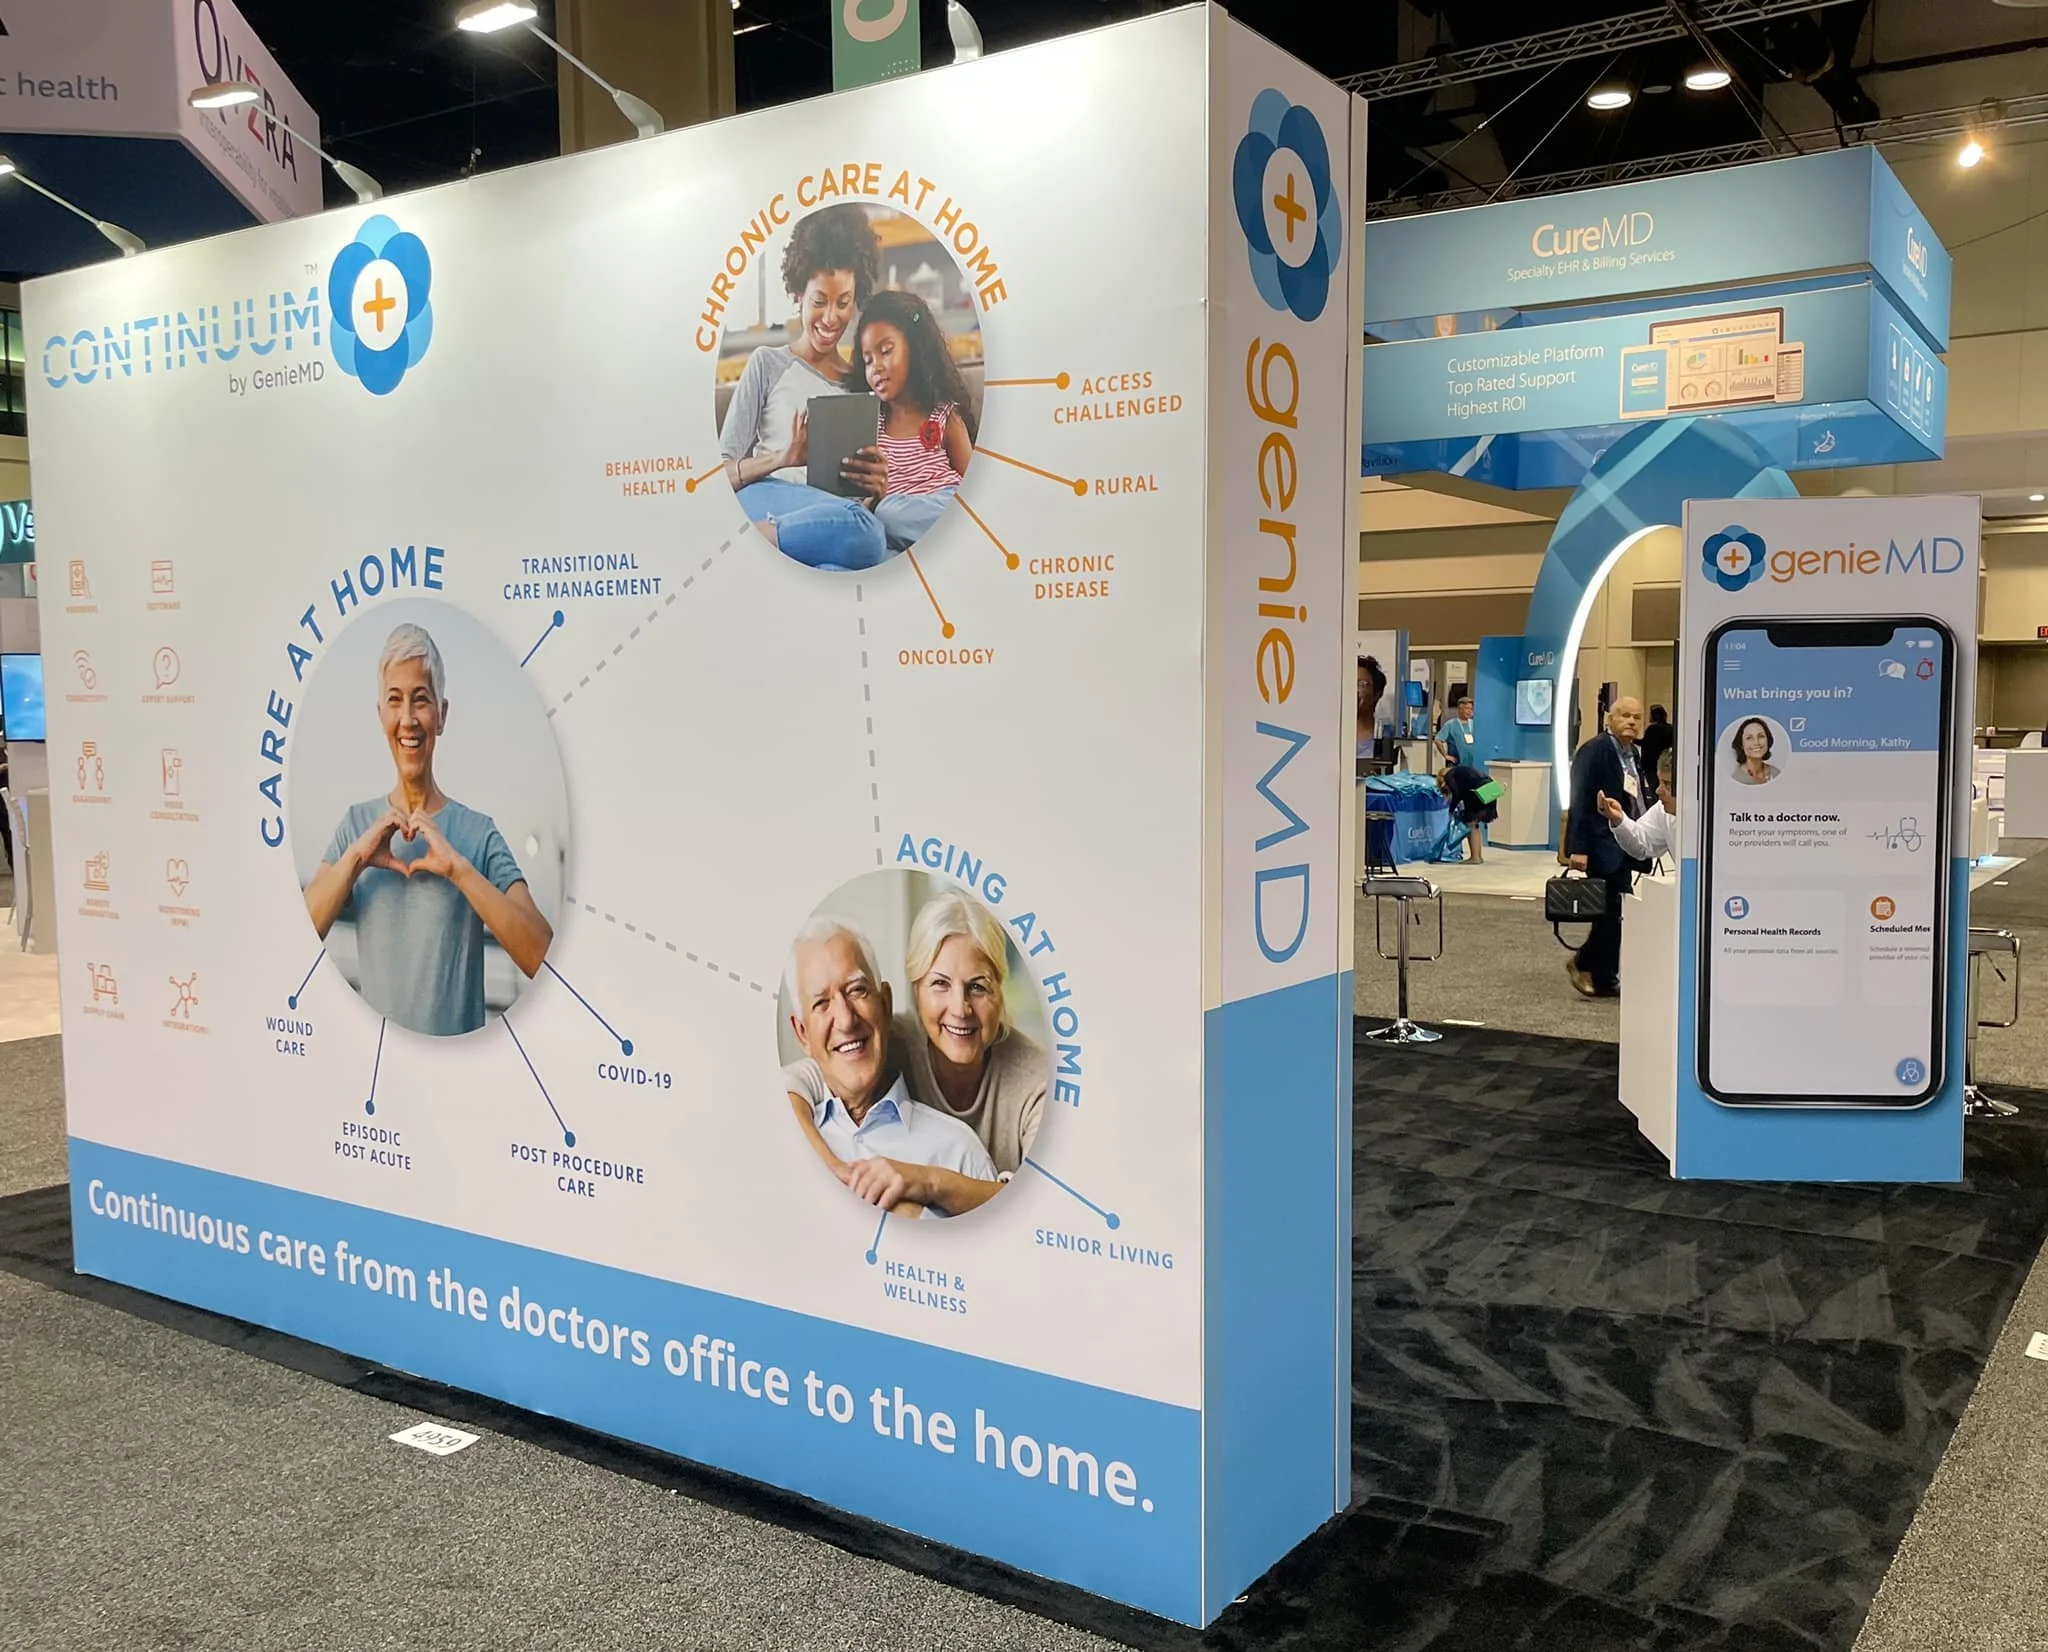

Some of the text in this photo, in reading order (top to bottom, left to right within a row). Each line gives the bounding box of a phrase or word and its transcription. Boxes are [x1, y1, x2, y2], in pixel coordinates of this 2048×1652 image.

[17, 71, 118, 101] health
[1532, 211, 1654, 257] CureMD
[304, 264, 318, 275] TM
[695, 163, 1008, 352] CHRONIC CARE AT HOME
[1507, 250, 1676, 282] Specialty EHR & Billing Services
[43, 286, 321, 388] CONTINUUM
[1447, 345, 1605, 373] Customizable Platform
[229, 361, 324, 396] by GenieMD
[1082, 371, 1153, 395] ACCESS
[1448, 370, 1576, 396] Top Rated Support
[1054, 394, 1183, 424] CHALLENGED
[1447, 396, 1526, 419] Highest ROI
[606, 456, 693, 477] BEHAVIORAL
[623, 479, 676, 496] HEALTH
[1095, 475, 1158, 495] RURAL
[522, 553, 638, 575] TRANSITIONAL
[1029, 555, 1115, 575] CHRONIC
[1770, 537, 1964, 583] genieMD
[503, 578, 661, 600] CARE MANAGEMENT
[1035, 580, 1109, 600] DISEASE
[899, 649, 995, 665] ONCOLOGY
[1246, 336, 1312, 964] genieMD
[259, 545, 445, 848] CARE AT HOME
[1723, 686, 1853, 702] What brings you in?
[1799, 737, 1911, 749] Good Morning, Kathy
[1729, 812, 1752, 822] Talk
[1754, 813, 1765, 822] to
[1776, 812, 1812, 822] doctor
[1814, 814, 1840, 822] now.
[1729, 828, 1756, 838] Report
[1758, 830, 1775, 838] your
[1839, 827, 1848, 836] of
[1744, 838, 1781, 848] providers
[1783, 838, 1796, 847] will
[1798, 838, 1812, 847] call
[1724, 927, 1822, 936] Personal Health Records
[1870, 924, 1913, 933] Scheduled
[896, 833, 1083, 1108] AGING AT HOME
[266, 1016, 313, 1036] WOUND
[276, 1039, 306, 1056] CARE
[598, 1063, 671, 1089] COVID-19
[343, 1121, 400, 1146] EPISODIC
[335, 1141, 411, 1170] POST ACUTE
[511, 1143, 644, 1184] POST PROCEDURE
[558, 1176, 595, 1198] CARE
[1035, 1228, 1174, 1270] SENIOR LIVING
[885, 1261, 966, 1291] HEALTH &
[884, 1281, 967, 1314] WELLNESS
[88, 1179, 1155, 1513] Continuous care from the doctors office to the home.
